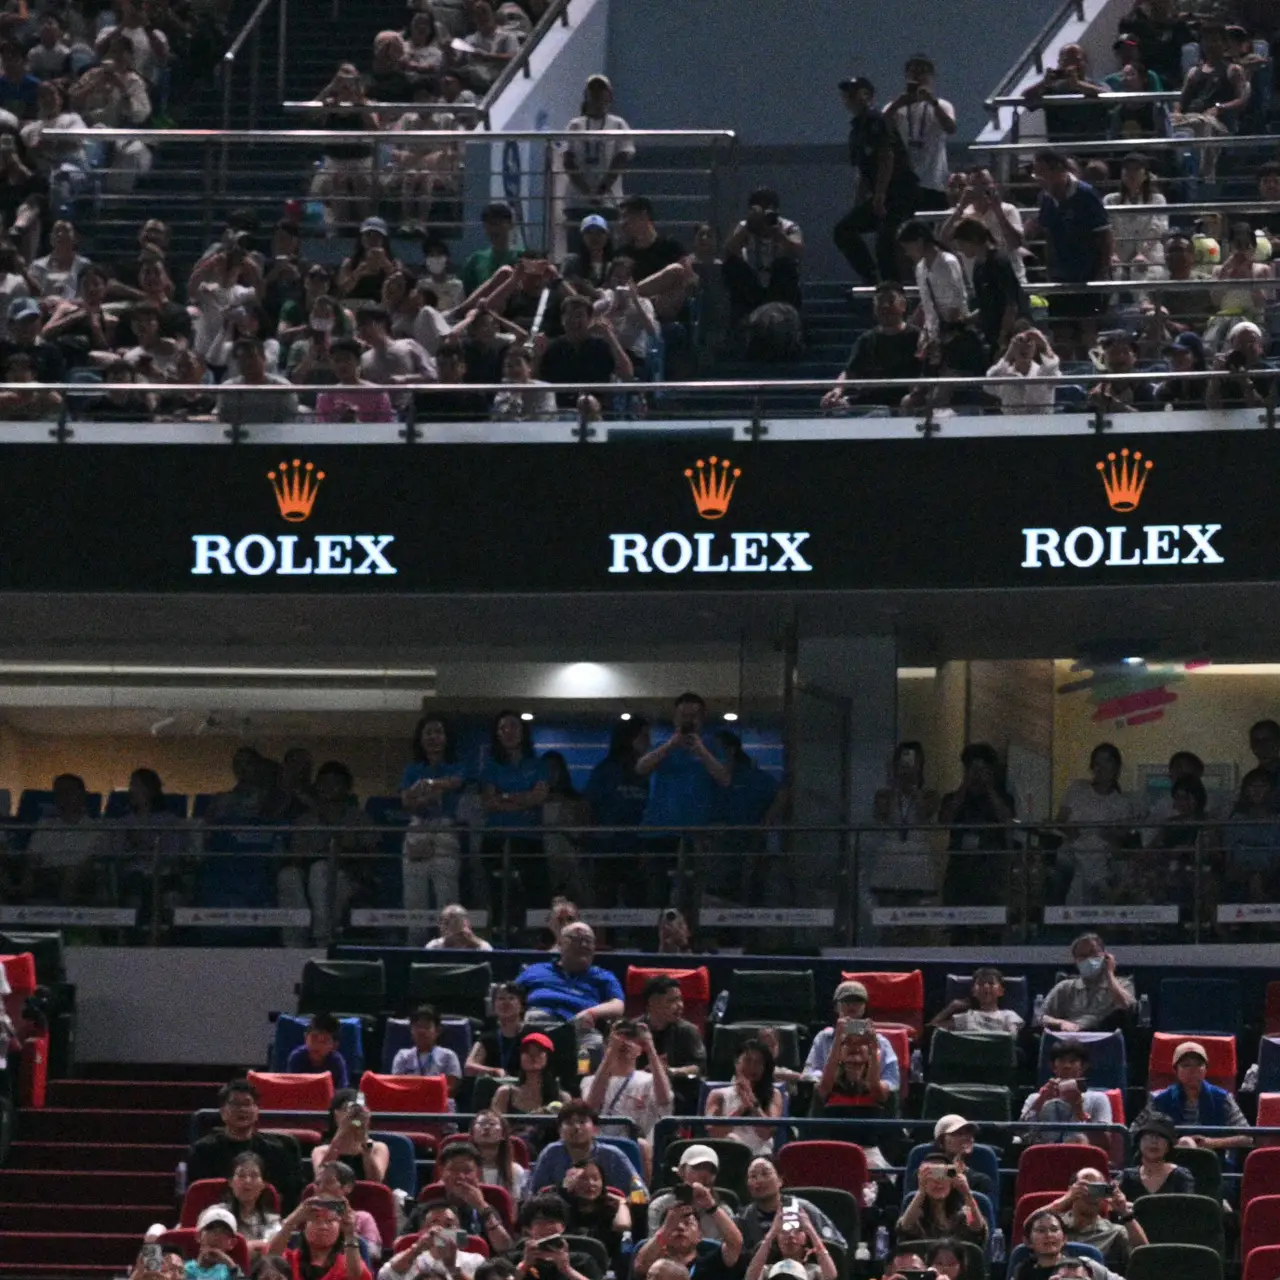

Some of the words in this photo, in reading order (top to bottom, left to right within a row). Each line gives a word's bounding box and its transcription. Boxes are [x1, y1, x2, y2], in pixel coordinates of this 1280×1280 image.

[192, 535, 396, 575] ROLEX
[609, 533, 812, 573] ROLEX
[1021, 524, 1224, 567] ROLEX
